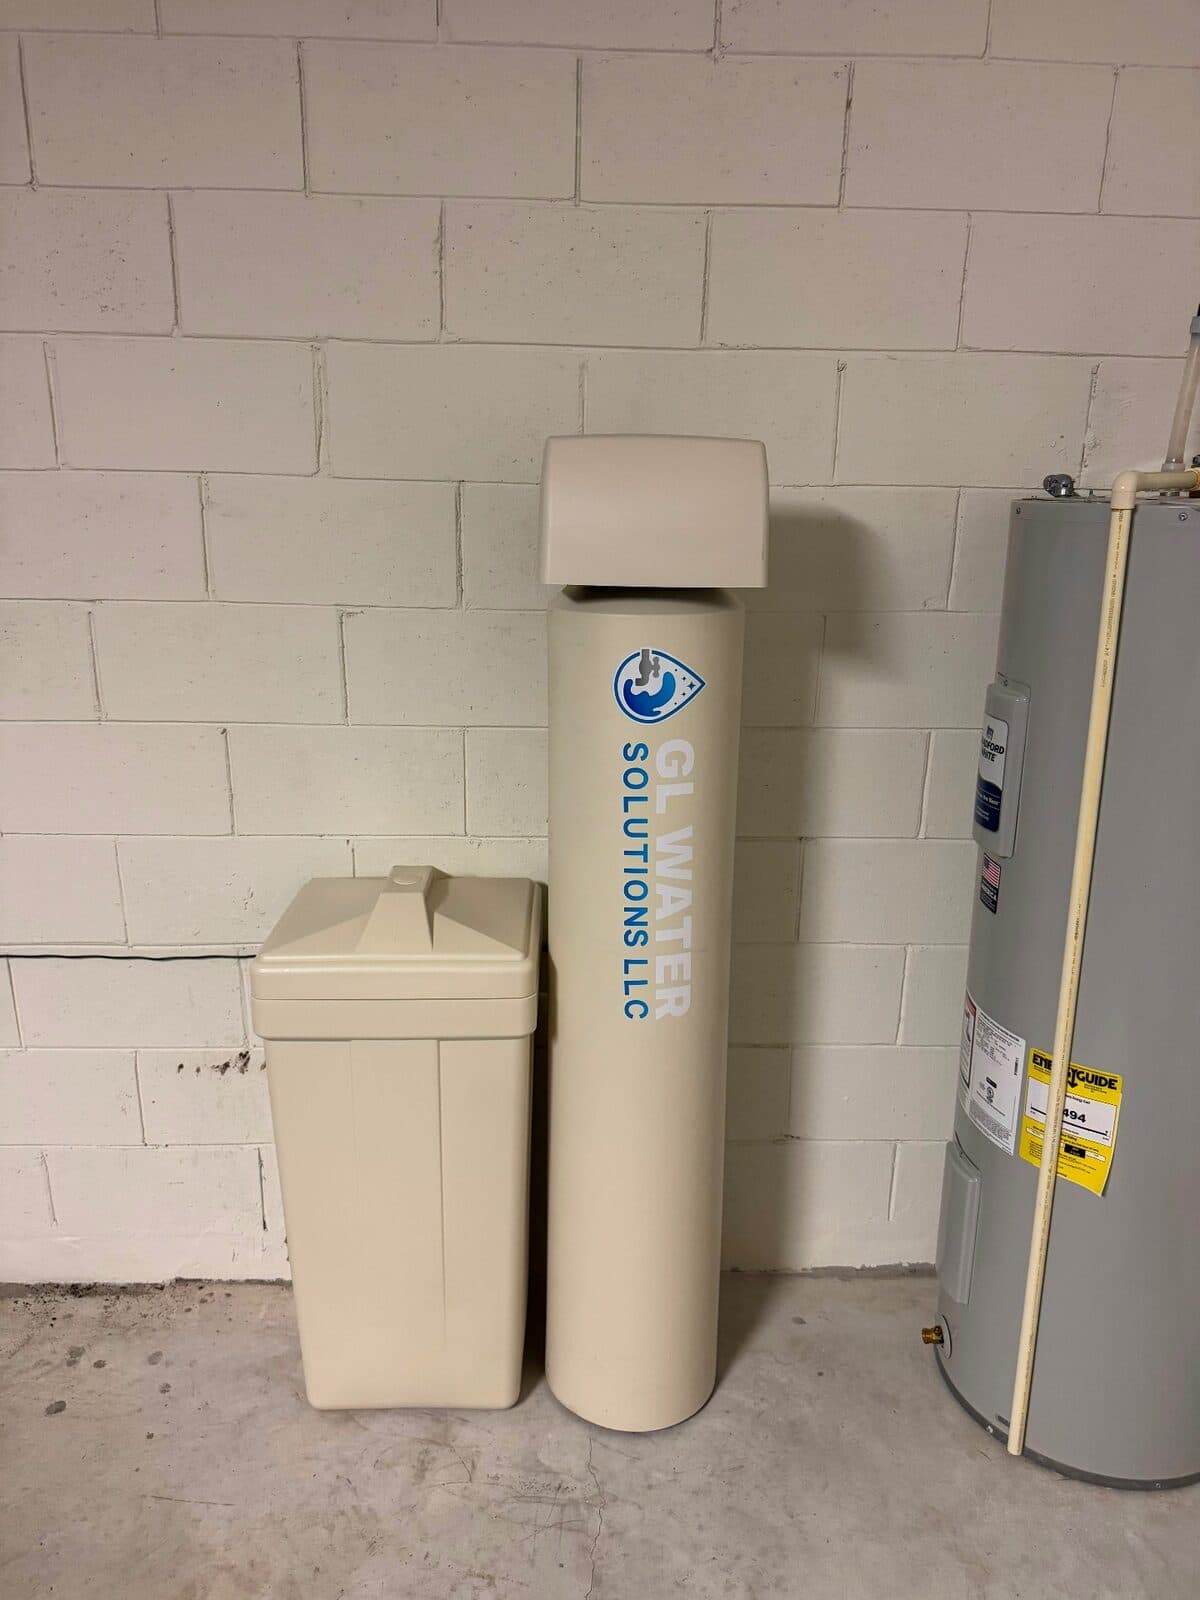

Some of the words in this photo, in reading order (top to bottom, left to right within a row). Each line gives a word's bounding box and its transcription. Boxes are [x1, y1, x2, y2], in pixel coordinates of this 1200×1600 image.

[655, 739, 695, 814] GL
[983, 738, 1005, 754] ADFORD
[622, 742, 649, 948] SOLUTIONS
[655, 825, 694, 1020] WATER
[623, 959, 649, 1019] LLC
[1032, 1053, 1118, 1090] ENEYGUIDE
